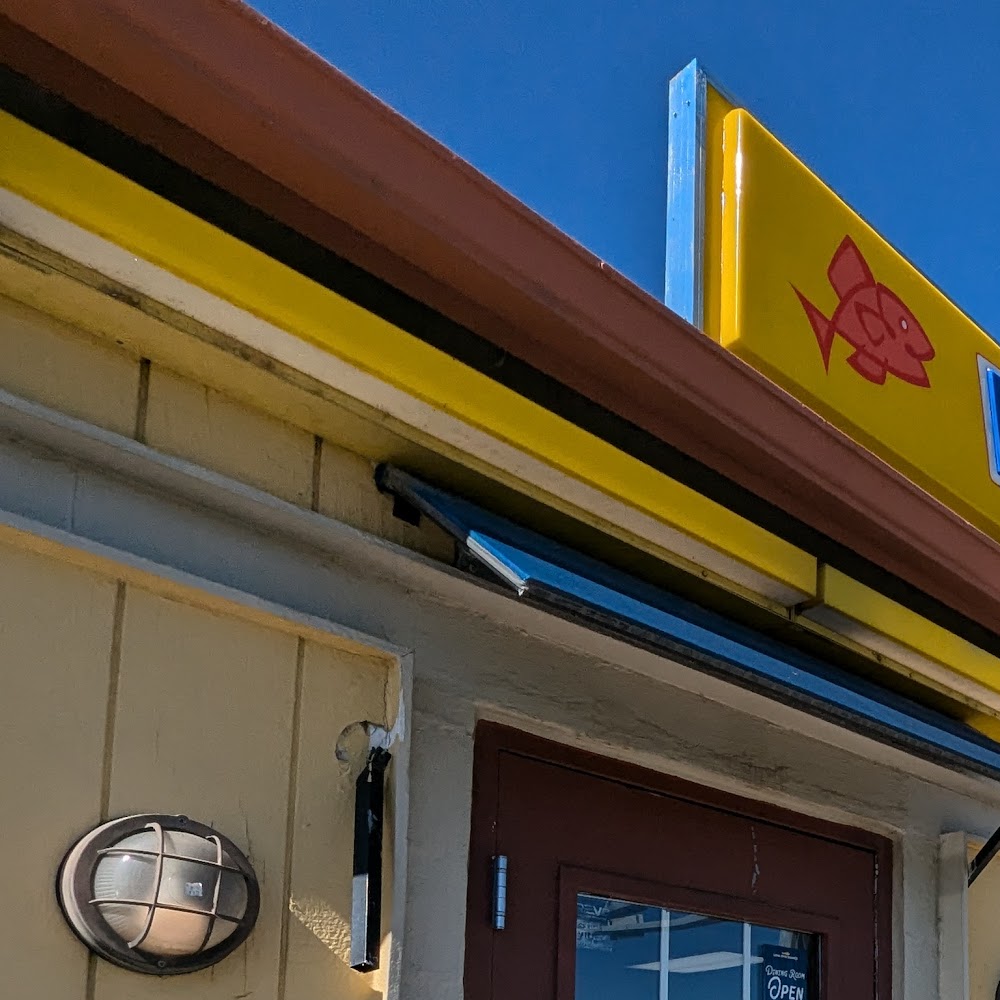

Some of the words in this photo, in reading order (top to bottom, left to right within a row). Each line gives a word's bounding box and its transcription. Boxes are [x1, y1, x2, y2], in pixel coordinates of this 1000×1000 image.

[765, 964, 788, 978] DINING
[789, 968, 806, 981] ROOM
[767, 975, 805, 1000] OPEN
